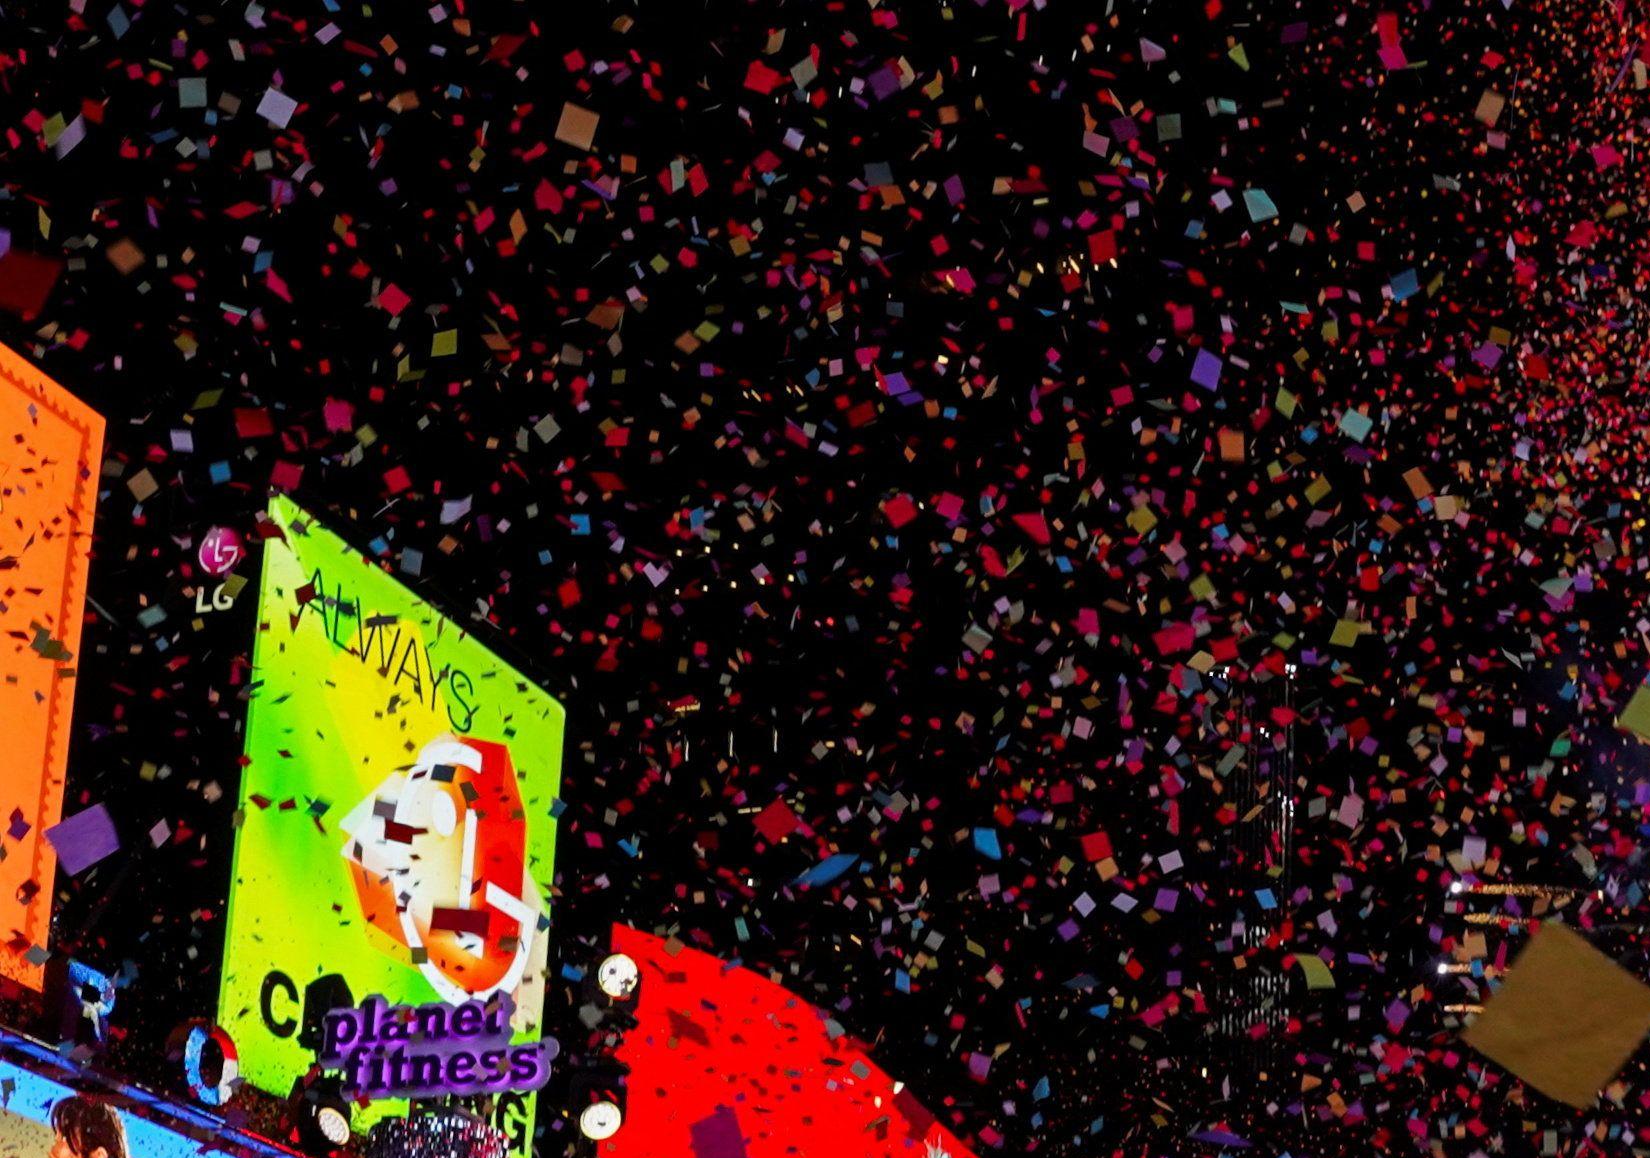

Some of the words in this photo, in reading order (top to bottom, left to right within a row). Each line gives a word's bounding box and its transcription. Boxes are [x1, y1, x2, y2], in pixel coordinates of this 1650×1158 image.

[195, 586, 235, 614] LG
[296, 567, 476, 743] ALWAYS
[318, 997, 503, 1062] planet
[345, 1047, 539, 1092] fitness
